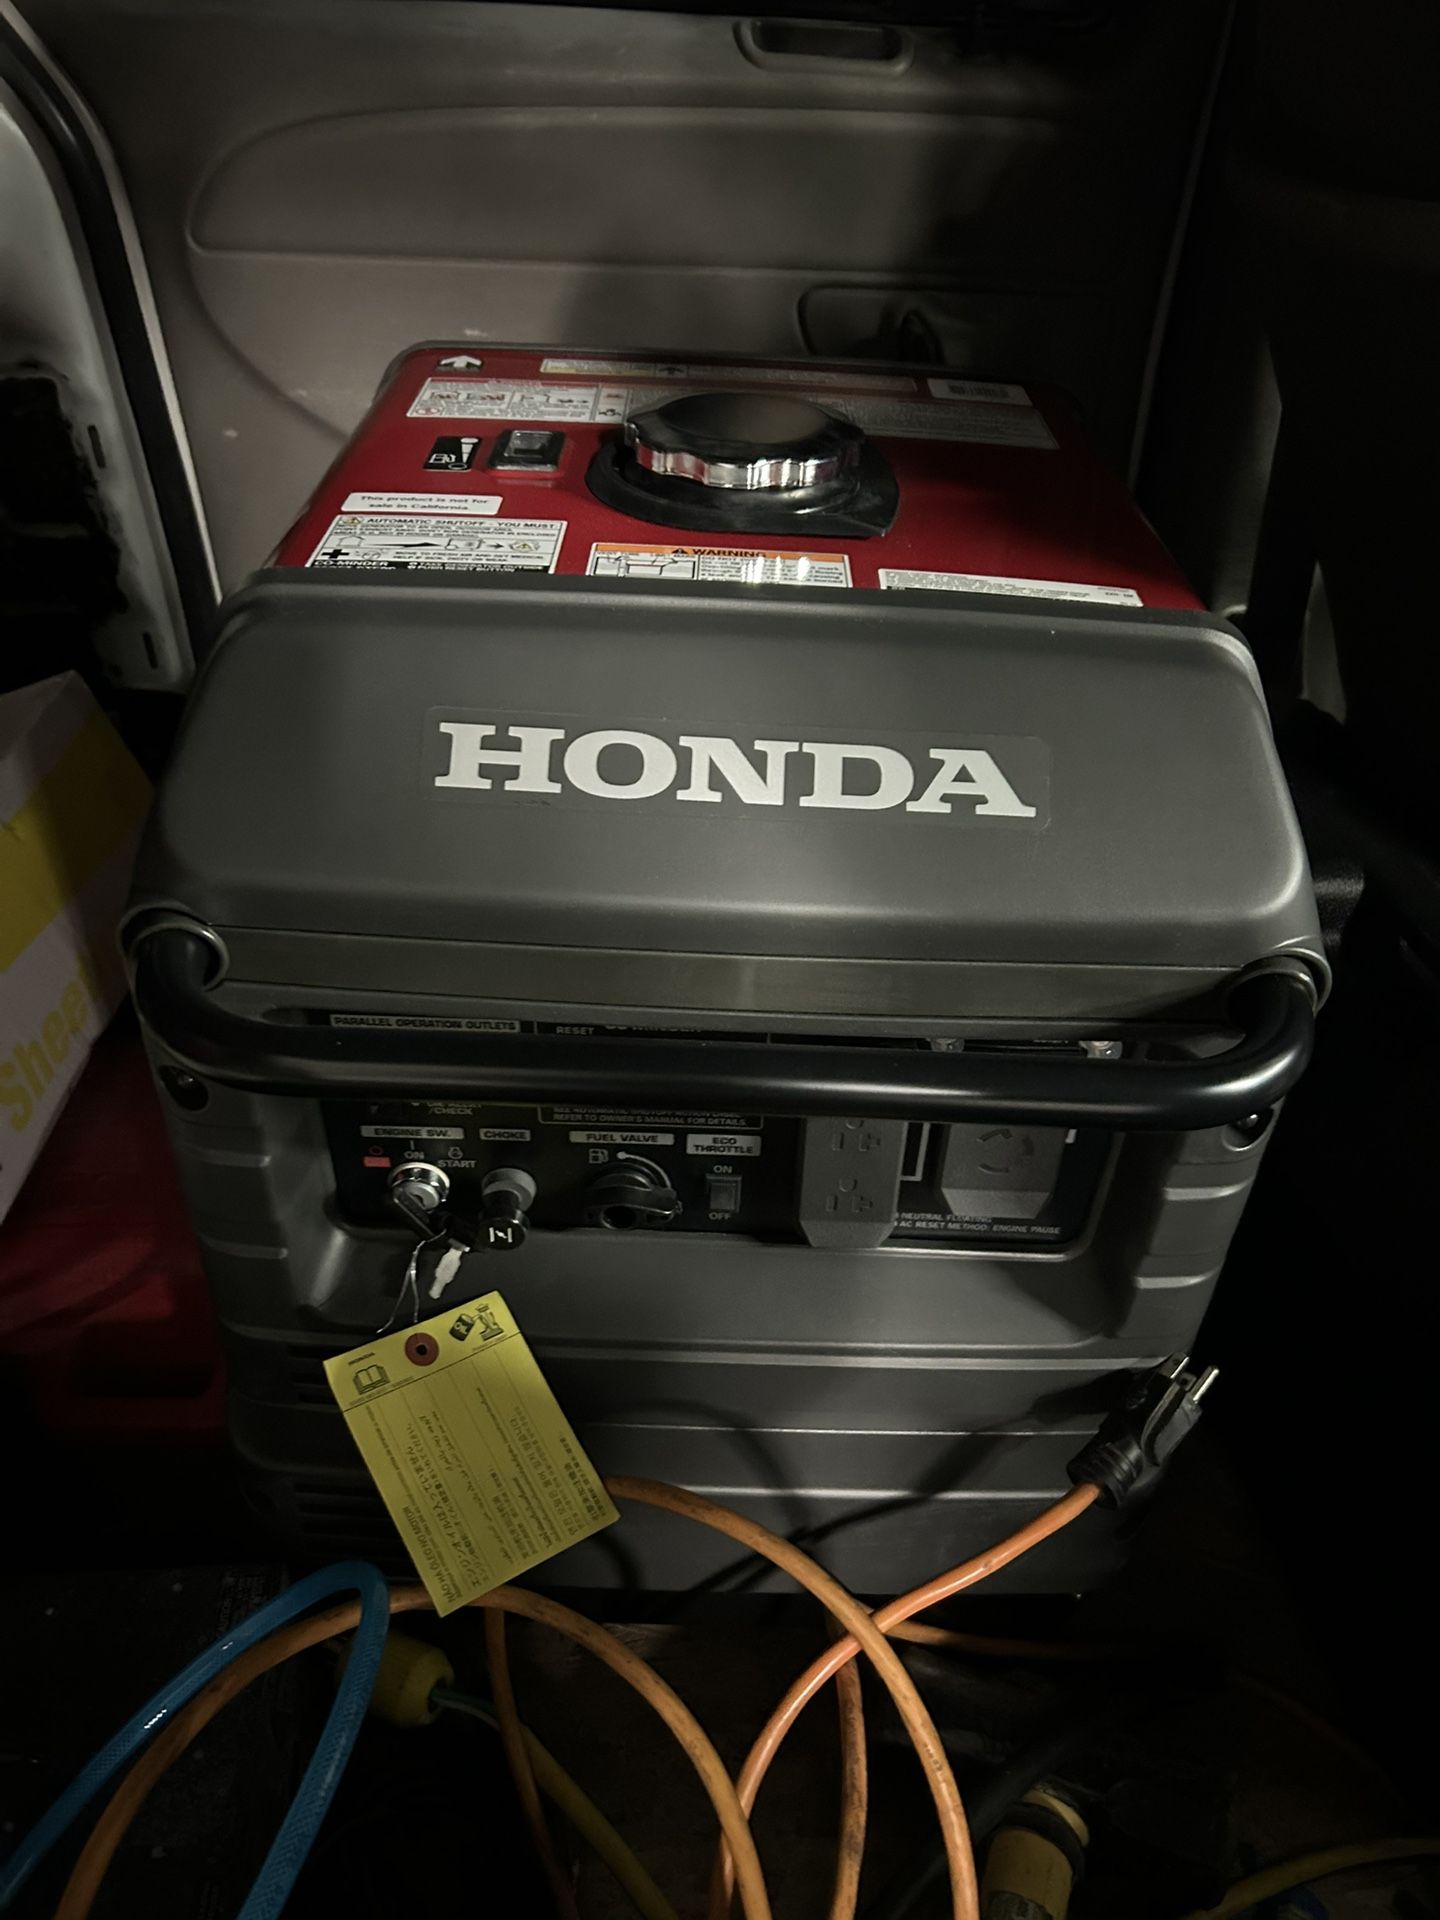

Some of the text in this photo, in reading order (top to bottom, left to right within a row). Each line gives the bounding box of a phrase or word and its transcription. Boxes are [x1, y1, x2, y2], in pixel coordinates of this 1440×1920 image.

[692, 548, 766, 559] WARNING
[435, 723, 1036, 817] HONDA
[334, 1016, 516, 1030] PARALLEL OPERATION OUTLETS
[556, 1026, 595, 1036] RESET
[428, 1107, 474, 1116] /CHECK
[584, 1114, 597, 1122] TO
[645, 1116, 686, 1124] MANUAL
[374, 1128, 422, 1136] ENGINE
[484, 1131, 527, 1139] CHOKE
[620, 1134, 658, 1142] VALVE
[712, 1136, 736, 1145] ECO
[694, 1144, 753, 1154] THROTTLE
[404, 1151, 424, 1160] ON
[437, 1159, 477, 1168] START
[713, 1164, 733, 1174] ON
[708, 1212, 732, 1221] OFF
[900, 1212, 992, 1223] NEUTRAL FLOATING
[916, 1222, 946, 1230] RESET
[992, 1224, 1028, 1234] ENGINE
[1030, 1226, 1062, 1235] PAUSE
[401, 1504, 422, 1535] MOTOR
[415, 1533, 429, 1549] NO
